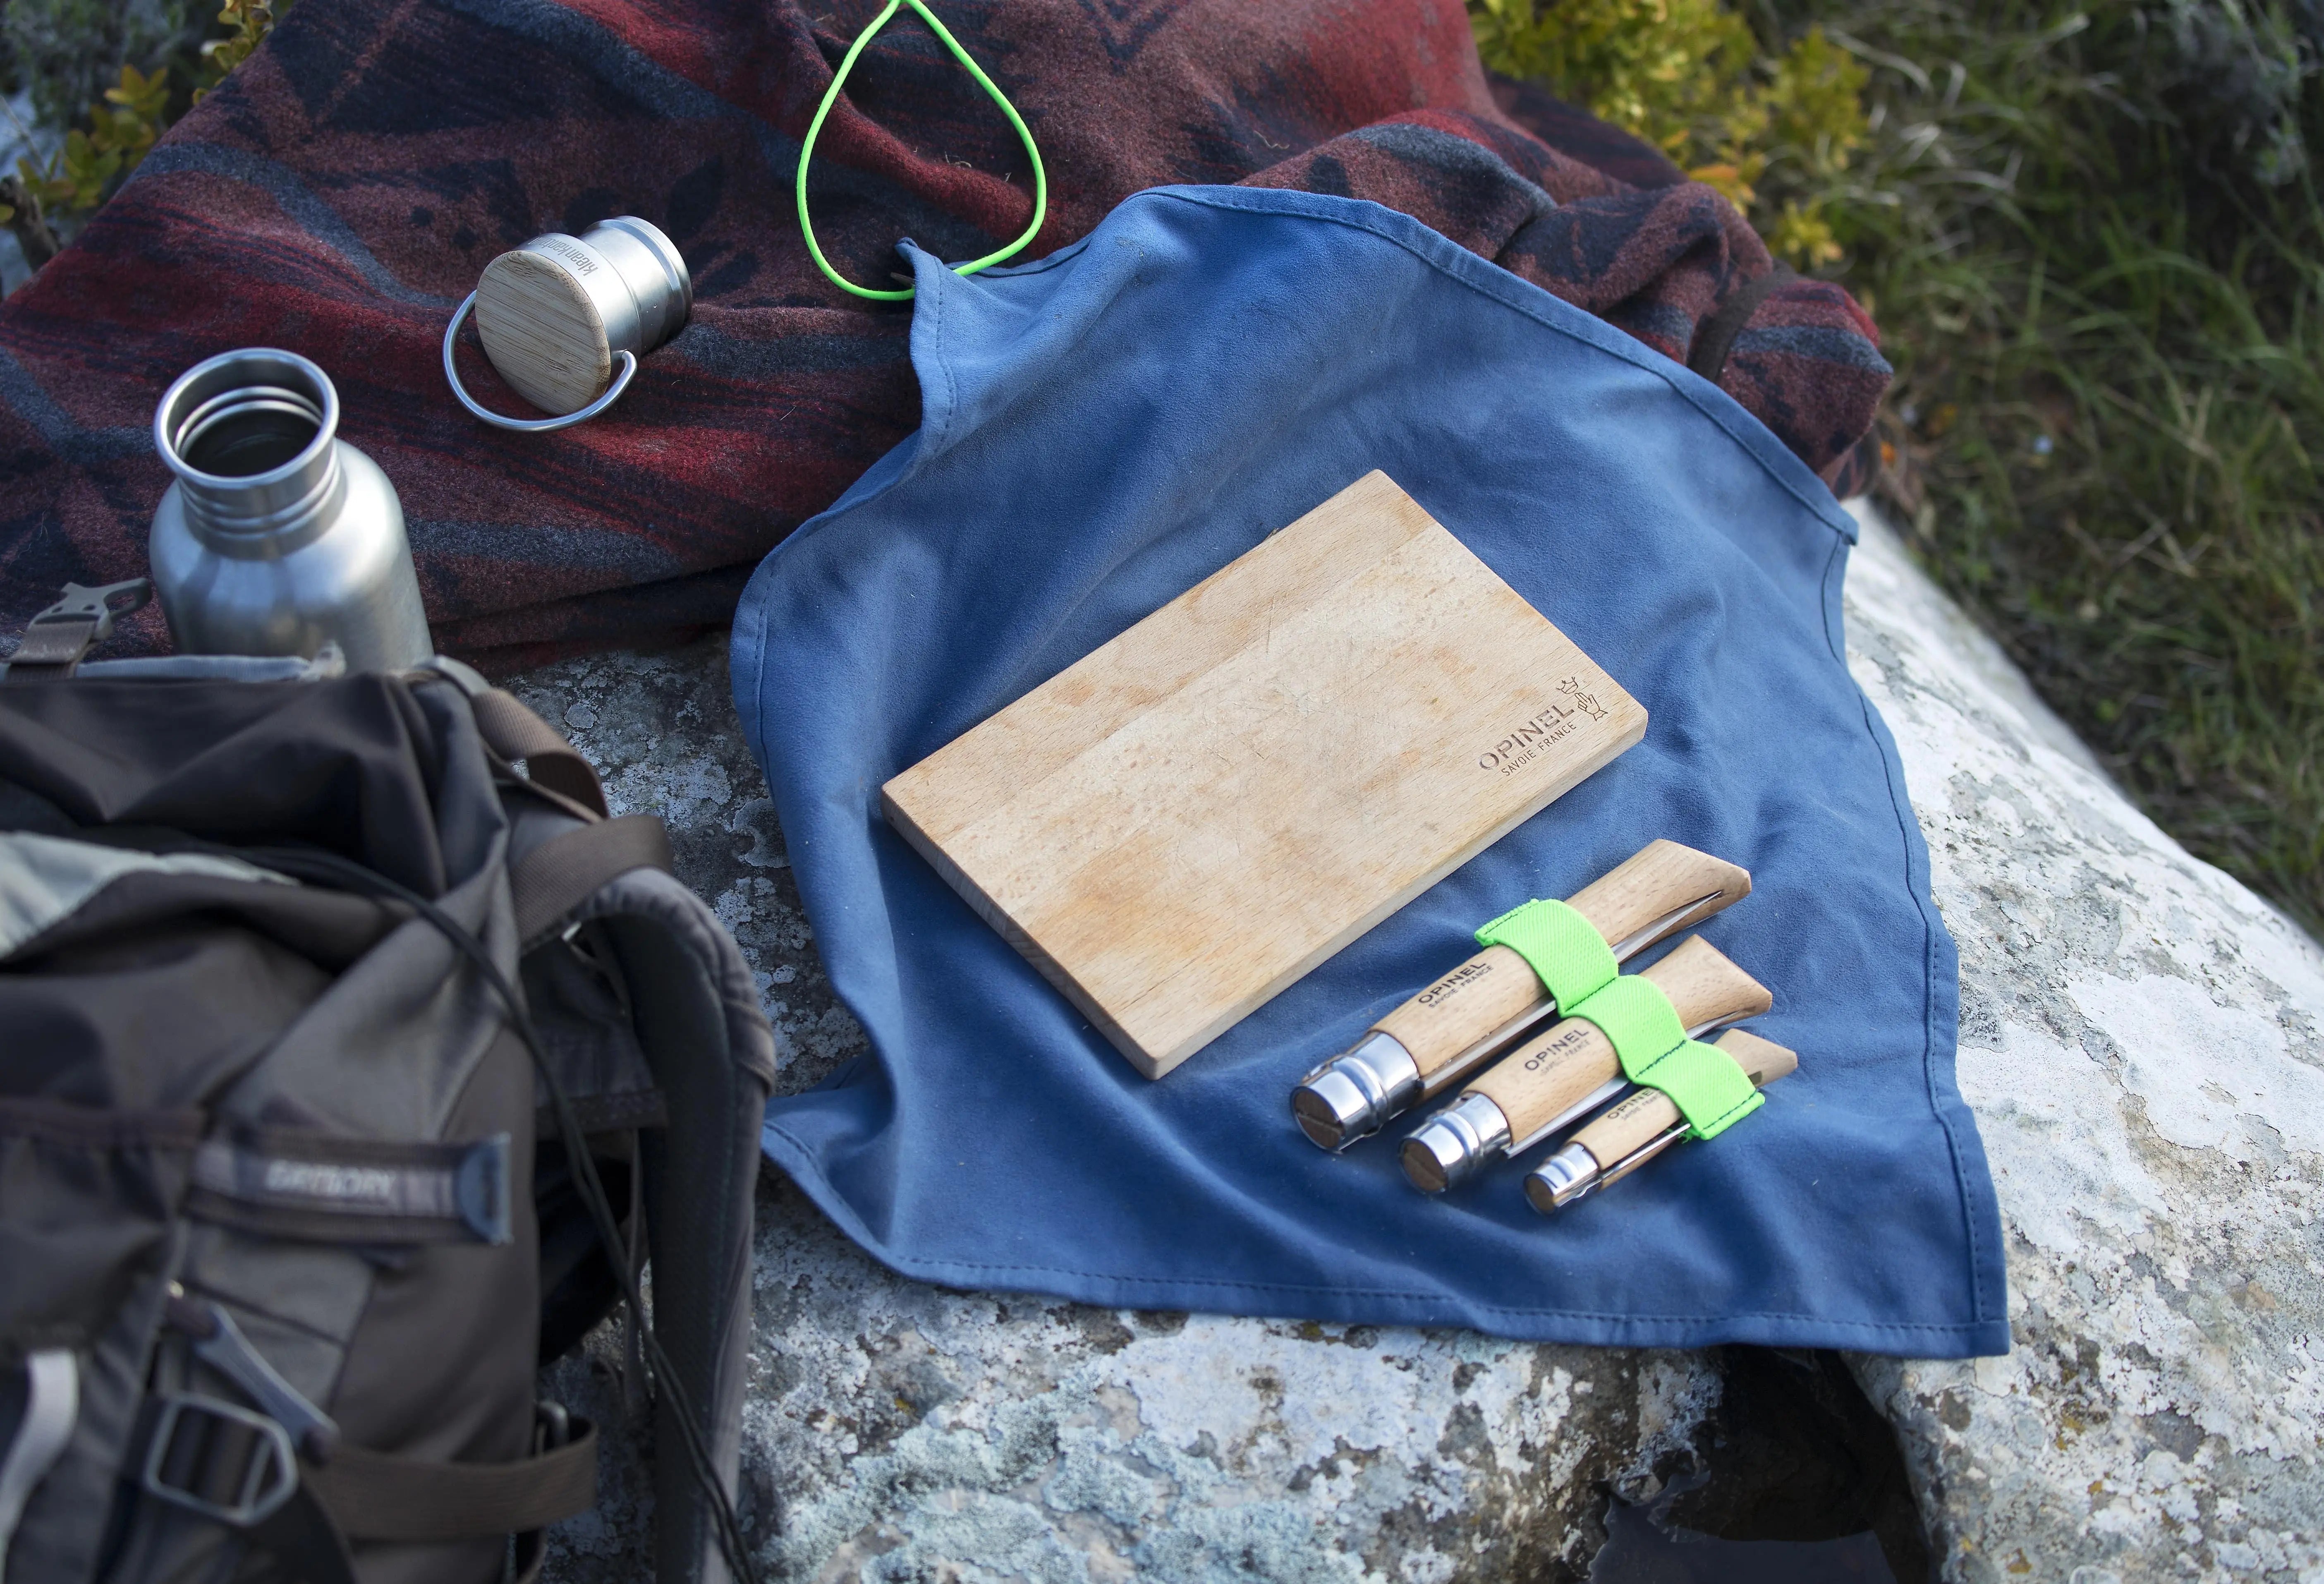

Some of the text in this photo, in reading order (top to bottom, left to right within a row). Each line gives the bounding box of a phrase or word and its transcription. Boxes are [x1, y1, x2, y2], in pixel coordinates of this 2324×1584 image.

[565, 249, 598, 276] klean
[1479, 705, 1575, 770] OPINEL
[1501, 721, 1577, 776] SAVOIE FRANCE
[1419, 963, 1486, 1004] OPINEL
[1461, 965, 1494, 987] FRANCE
[1525, 1029, 1589, 1071] OPINEL
[1608, 1090, 1654, 1119] OPINE
